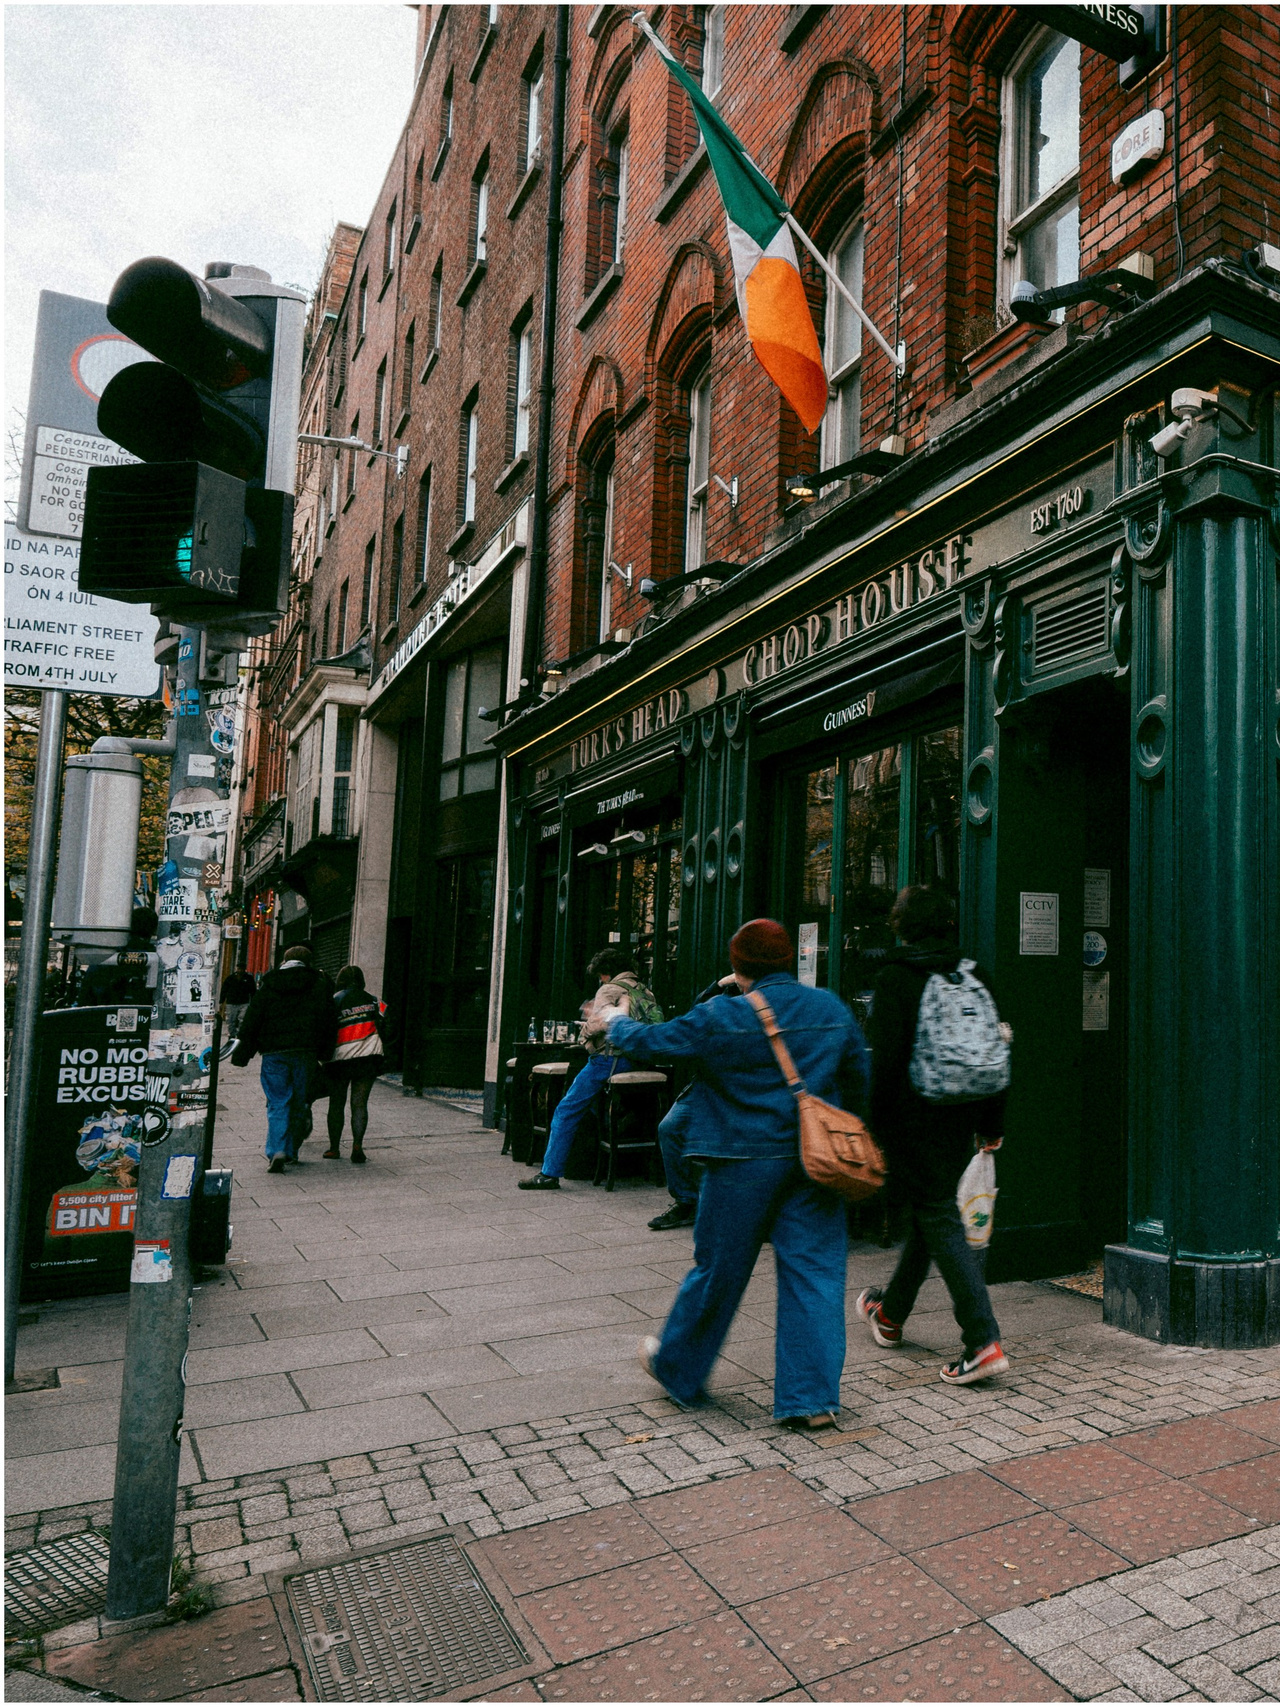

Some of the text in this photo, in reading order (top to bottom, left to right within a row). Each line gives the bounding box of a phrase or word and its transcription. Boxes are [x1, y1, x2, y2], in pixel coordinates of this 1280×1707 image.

[1077, 5, 1138, 35] NESS
[1114, 126, 1150, 165] CORE
[53, 433, 113, 452] Ceantar
[55, 462, 84, 475] Cosc
[51, 485, 70, 497] NO
[40, 494, 65, 507] FOR
[1030, 486, 1082, 534] EST 1760
[4, 538, 22, 551] ID
[27, 541, 49, 555] NA
[19, 564, 65, 581] SAOR
[27, 584, 50, 601] ÓN
[55, 590, 64, 602] 4
[743, 534, 966, 686] CHOP HOUSE
[4, 616, 144, 643] LIAMENT STREET
[4, 639, 116, 662] TRAFFIC FREE
[44, 666, 74, 681] 4TH
[79, 669, 119, 684] JULY
[823, 698, 868, 732] GUINNESS
[569, 688, 684, 772] TURK'S HEAD
[180, 905, 192, 915] TE
[1025, 900, 1054, 911] CCTV
[60, 1048, 99, 1065] NO
[58, 1066, 146, 1085] RUBBI
[59, 1193, 134, 1206] 3,500 city litter
[56, 1206, 111, 1230] BIN
